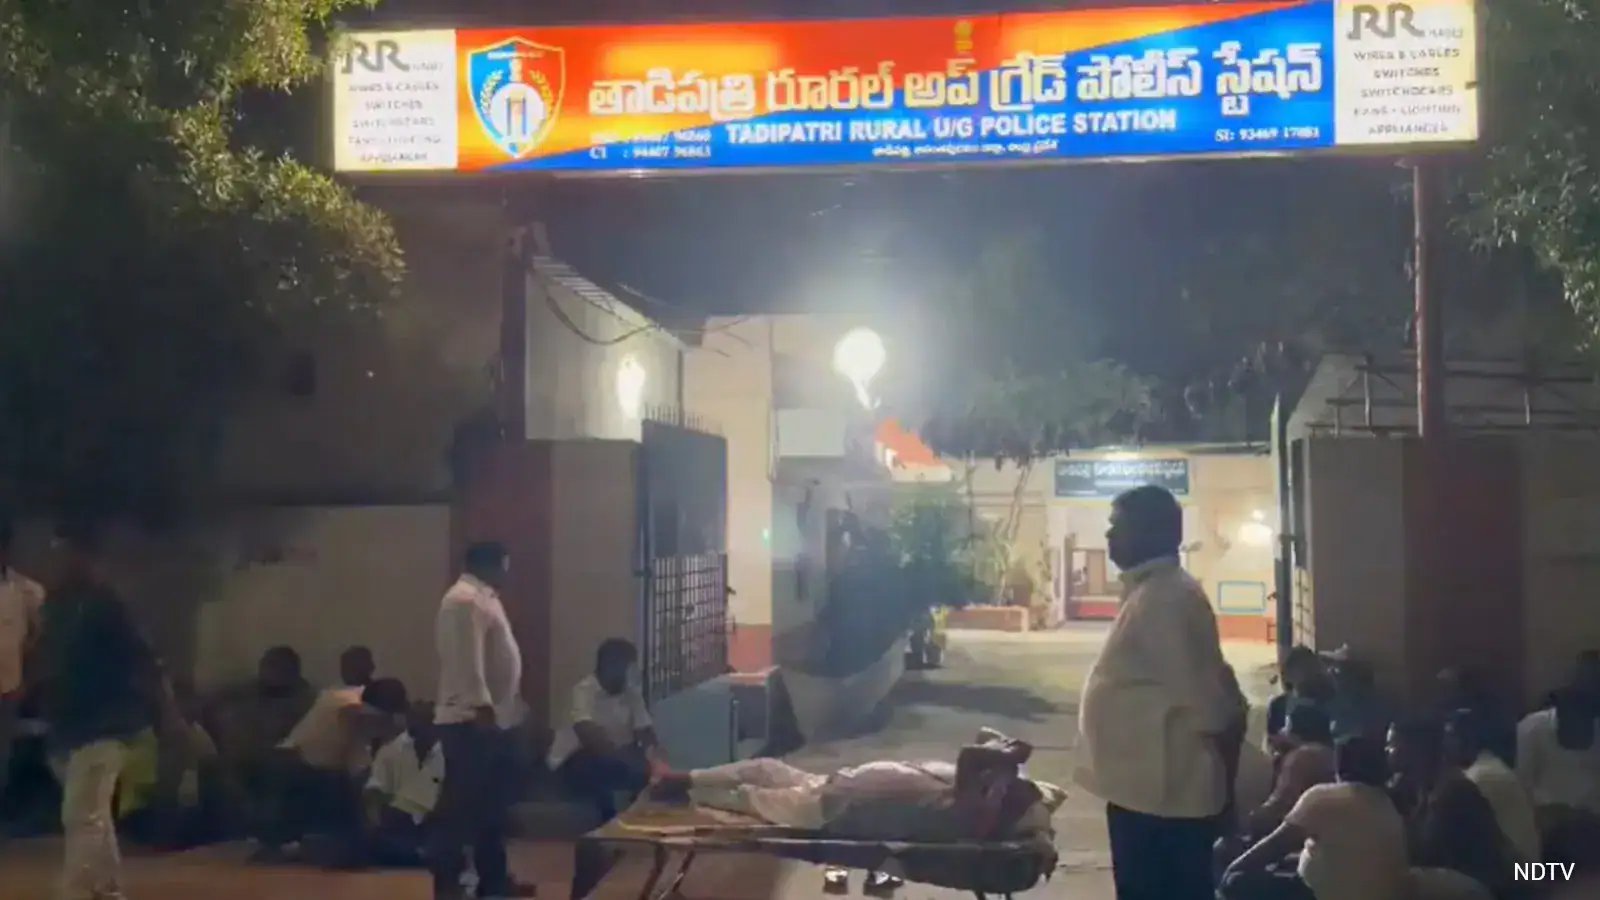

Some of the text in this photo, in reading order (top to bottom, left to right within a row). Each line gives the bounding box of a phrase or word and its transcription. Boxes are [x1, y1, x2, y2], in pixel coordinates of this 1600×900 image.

[1347, 4, 1425, 40] RR
[588, 67, 756, 121] తాడిపత్రి
[766, 60, 895, 111] రూరల్
[1076, 47, 1203, 102] పోలీస్
[1212, 40, 1322, 116] స్టేషన్
[725, 121, 842, 145] TADIPATRI
[850, 119, 927, 142] RURAL
[934, 116, 974, 138] U/G
[980, 112, 1068, 136] POLICE
[1073, 109, 1178, 134] STATION
